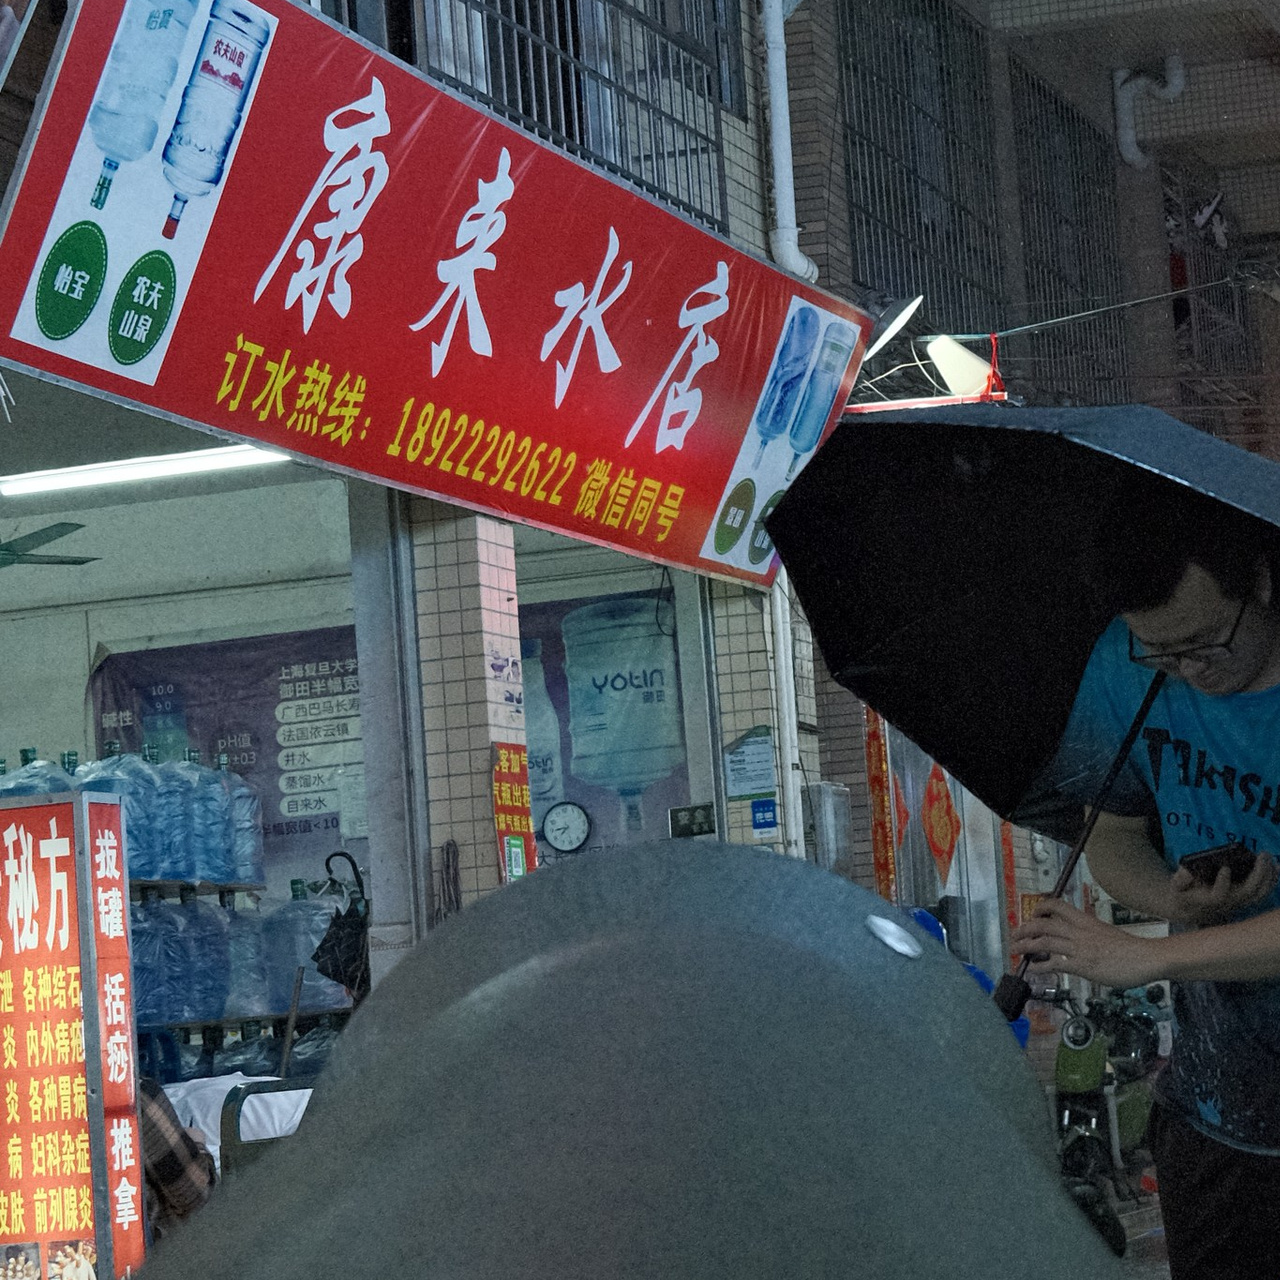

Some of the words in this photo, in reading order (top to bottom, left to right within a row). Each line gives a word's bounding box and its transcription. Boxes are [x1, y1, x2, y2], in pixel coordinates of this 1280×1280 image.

[212, 39, 247, 68] 农夫山泉
[53, 263, 90, 300] 怡宝
[131, 275, 165, 310] 农夫
[118, 310, 152, 343] 山泉
[386, 398, 577, 506] 18922292622
[574, 458, 686, 543] 微信同号
[152, 683, 174, 696] 10.0
[283, 750, 311, 764] 井水
[287, 797, 327, 813] 自来水
[0, 816, 71, 958] 秘方
[22, 964, 80, 1013] 各种结石
[3, 1024, 17, 1069] 炎
[95, 829, 125, 940] 拔罐
[110, 1118, 139, 1231] 推拿
[5, 1079, 21, 1123] 炎
[28, 1073, 88, 1122] 各种胃病
[7, 1134, 22, 1180] 病
[30, 1129, 91, 1177] 妇科杂症
[34, 1184, 93, 1234] 前列腺炎
